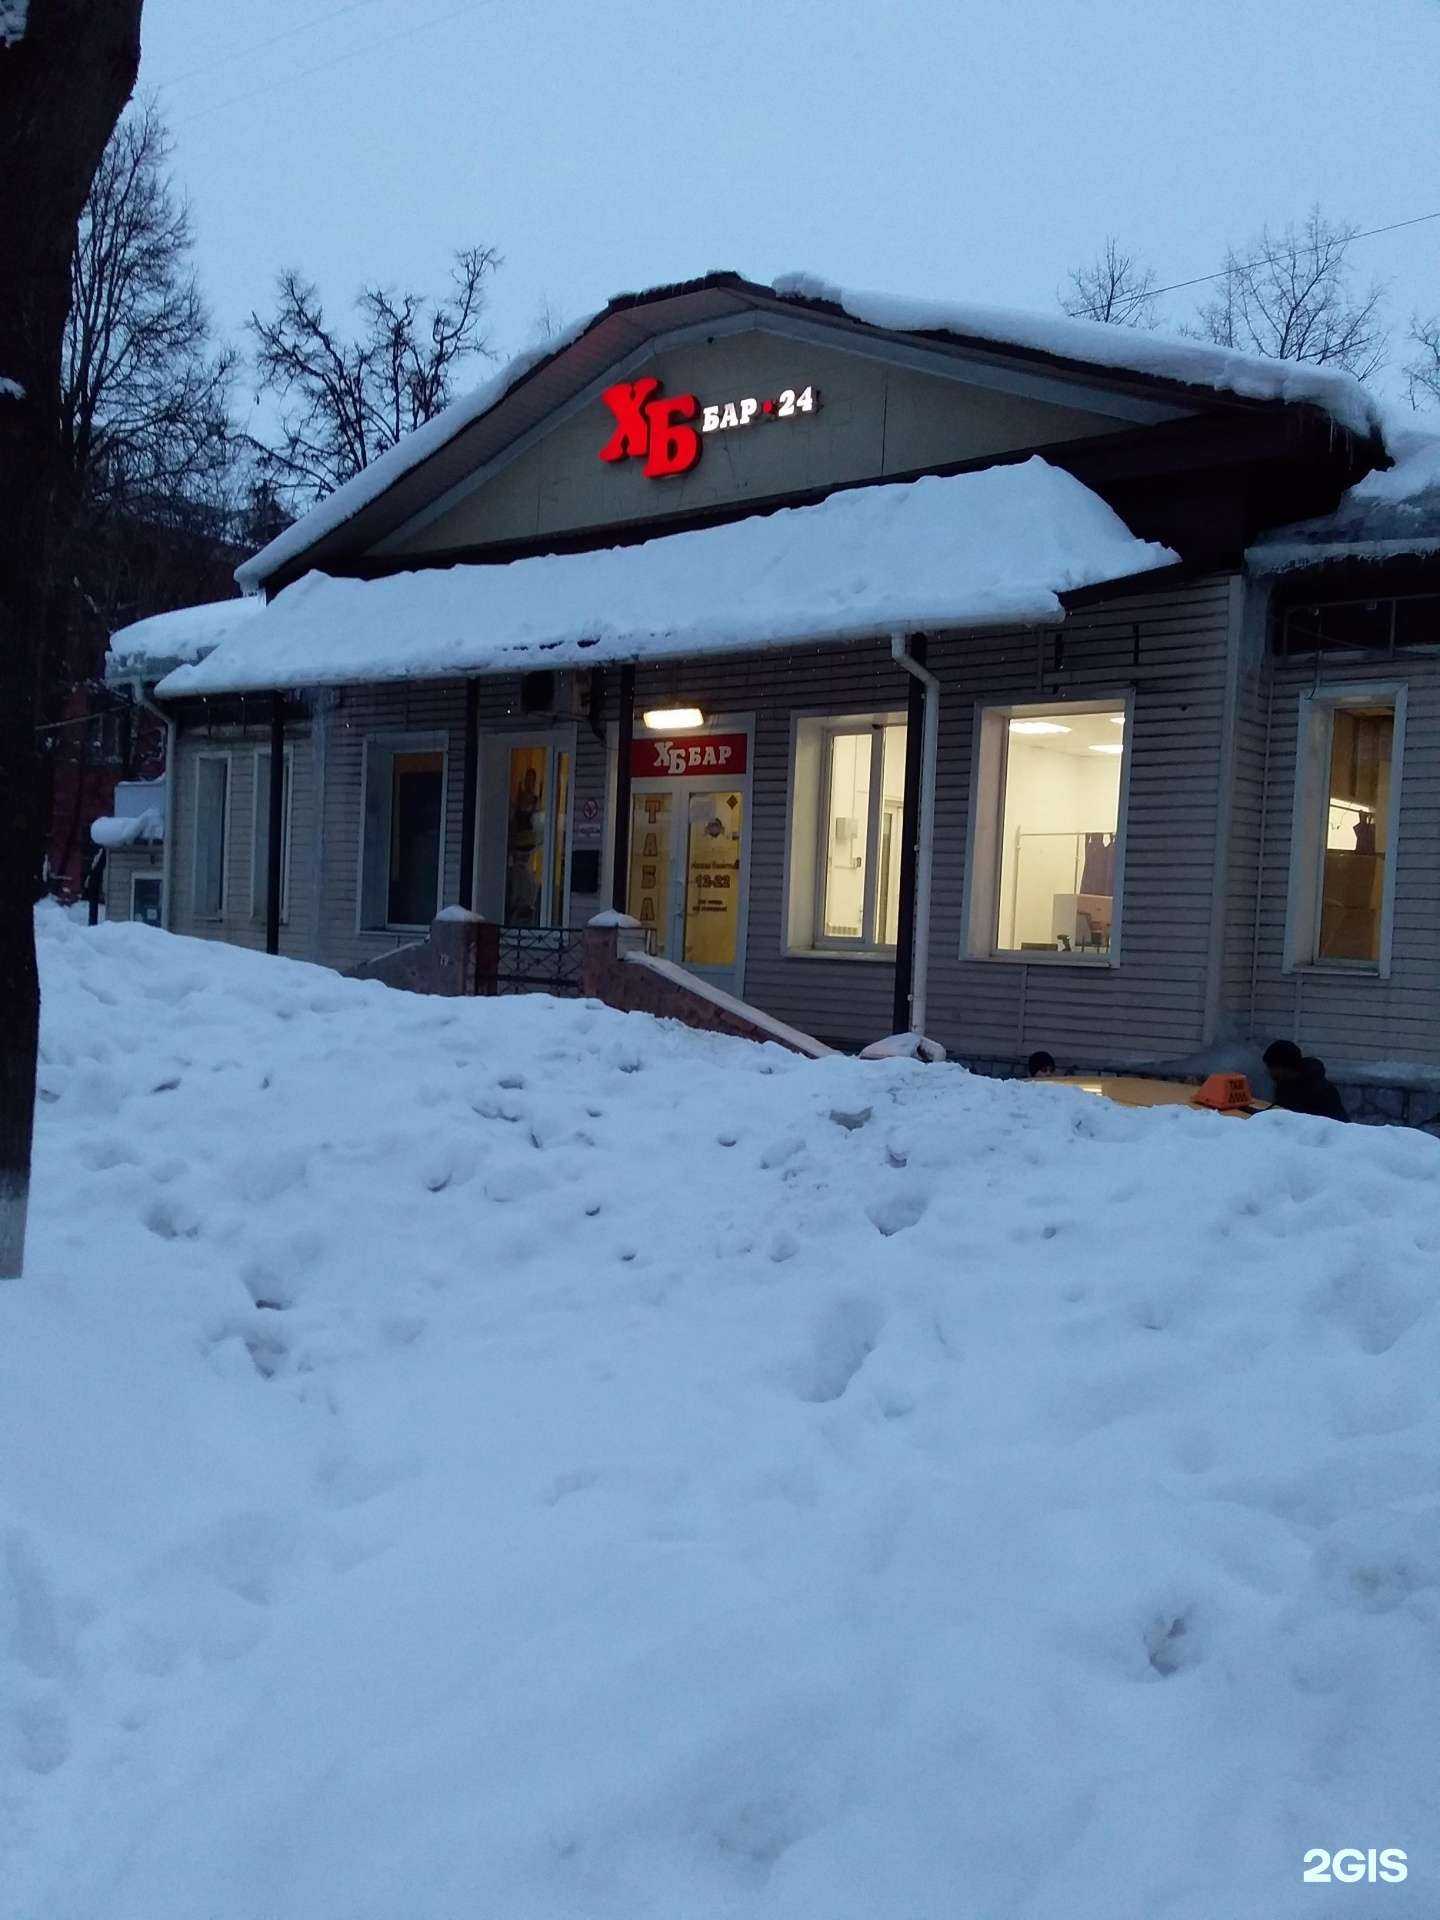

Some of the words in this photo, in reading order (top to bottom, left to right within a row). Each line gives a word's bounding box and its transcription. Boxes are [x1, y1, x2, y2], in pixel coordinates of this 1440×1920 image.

[598, 376, 699, 479] ХБ
[702, 398, 757, 433] БАР
[777, 386, 813, 417] 24
[653, 741, 686, 774] ХБ
[688, 745, 732, 766] БАР
